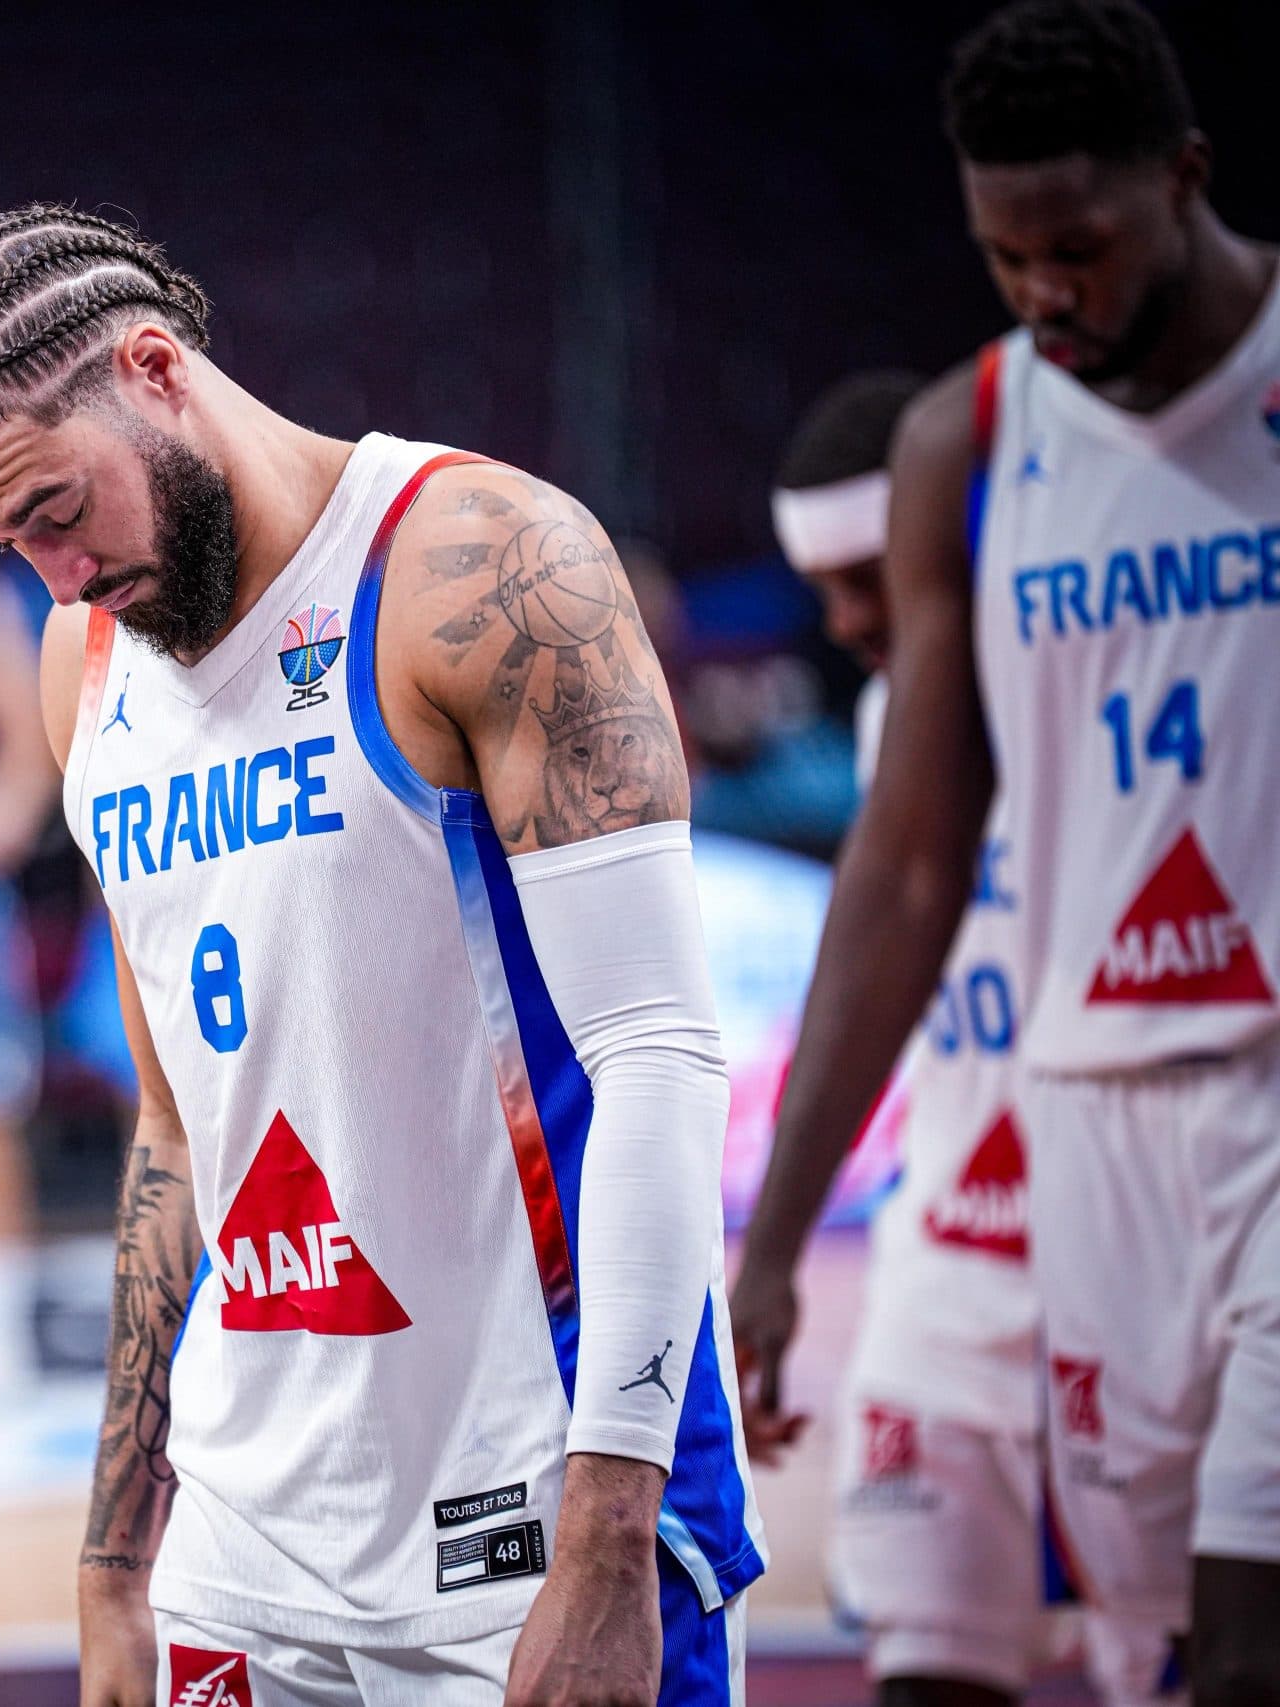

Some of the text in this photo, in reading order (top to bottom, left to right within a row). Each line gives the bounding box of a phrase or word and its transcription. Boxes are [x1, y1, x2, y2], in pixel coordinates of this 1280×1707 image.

[286, 681, 330, 712] 25
[1099, 678, 1203, 793] 14
[93, 736, 344, 889] FRANCE
[191, 923, 248, 1053] 8
[1100, 915, 1249, 990] MAIF
[214, 1220, 353, 1304] MAIF
[440, 1490, 522, 1520] TOUTES ET TOUS
[495, 1540, 521, 1562] 48
